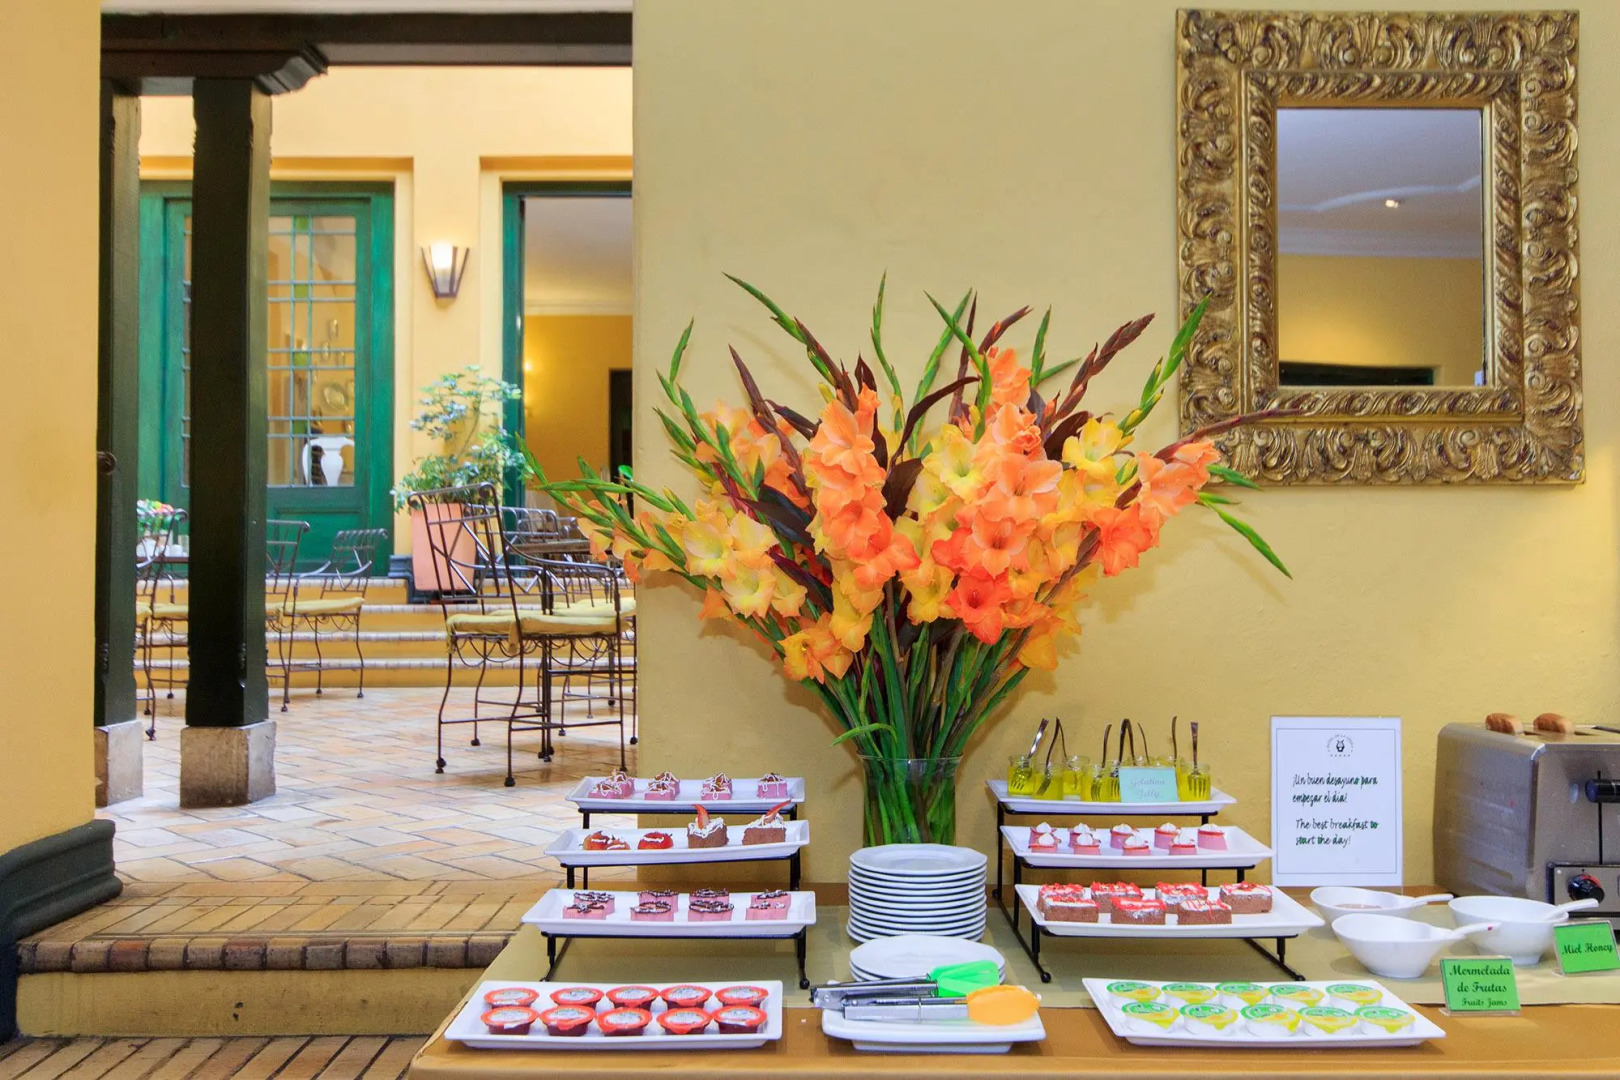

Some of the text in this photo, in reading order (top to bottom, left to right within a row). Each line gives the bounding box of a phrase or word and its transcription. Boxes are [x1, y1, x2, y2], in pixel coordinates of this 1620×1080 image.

[1307, 773, 1325, 785] buen
[1326, 773, 1359, 789] desayuno
[1361, 776, 1378, 789] para
[1324, 791, 1331, 803] el
[1296, 818, 1379, 831] The best breakfast to
[1296, 834, 1351, 848] start the day!
[1561, 942, 1613, 955] Miel Honey
[1449, 964, 1510, 976] Mermelada
[1457, 981, 1507, 993] de Frutas
